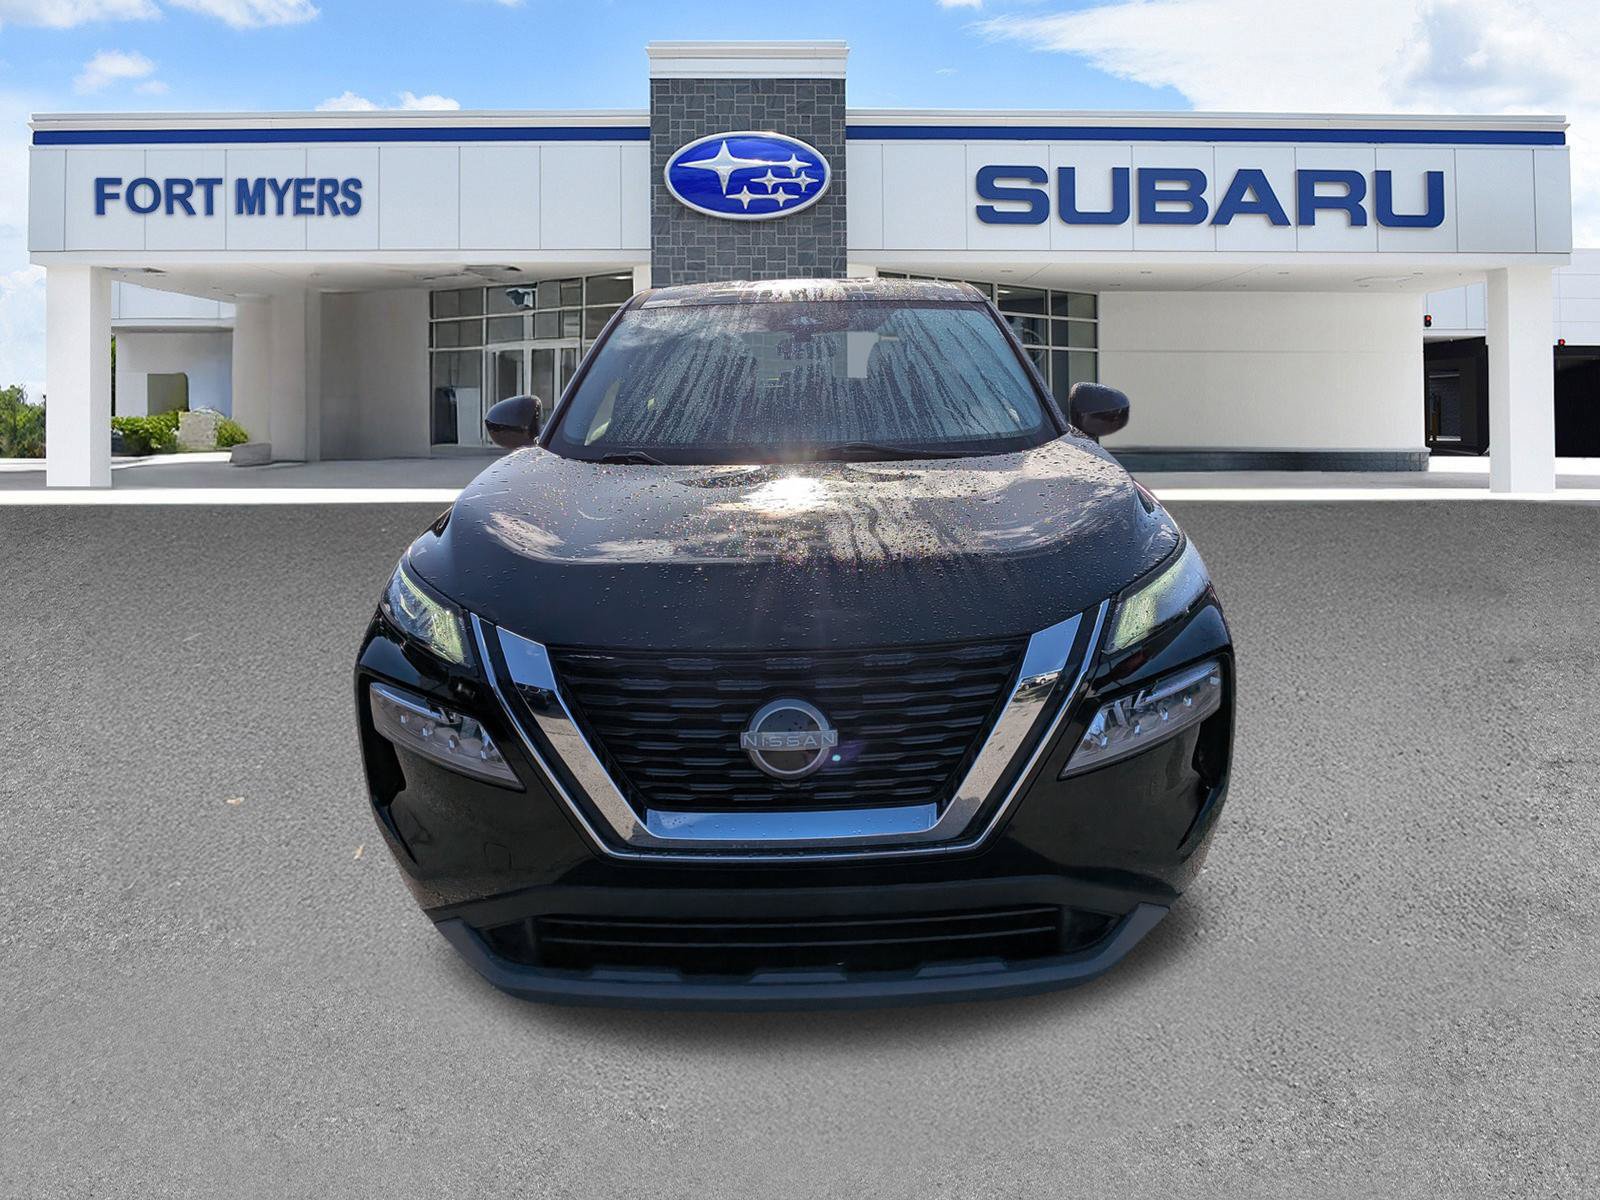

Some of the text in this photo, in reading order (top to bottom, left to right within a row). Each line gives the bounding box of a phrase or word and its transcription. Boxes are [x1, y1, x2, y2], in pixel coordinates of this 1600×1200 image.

[94, 177, 363, 217] FORT MYERS
[975, 164, 1446, 229] SUBARU
[743, 732, 835, 748] NISSAN
